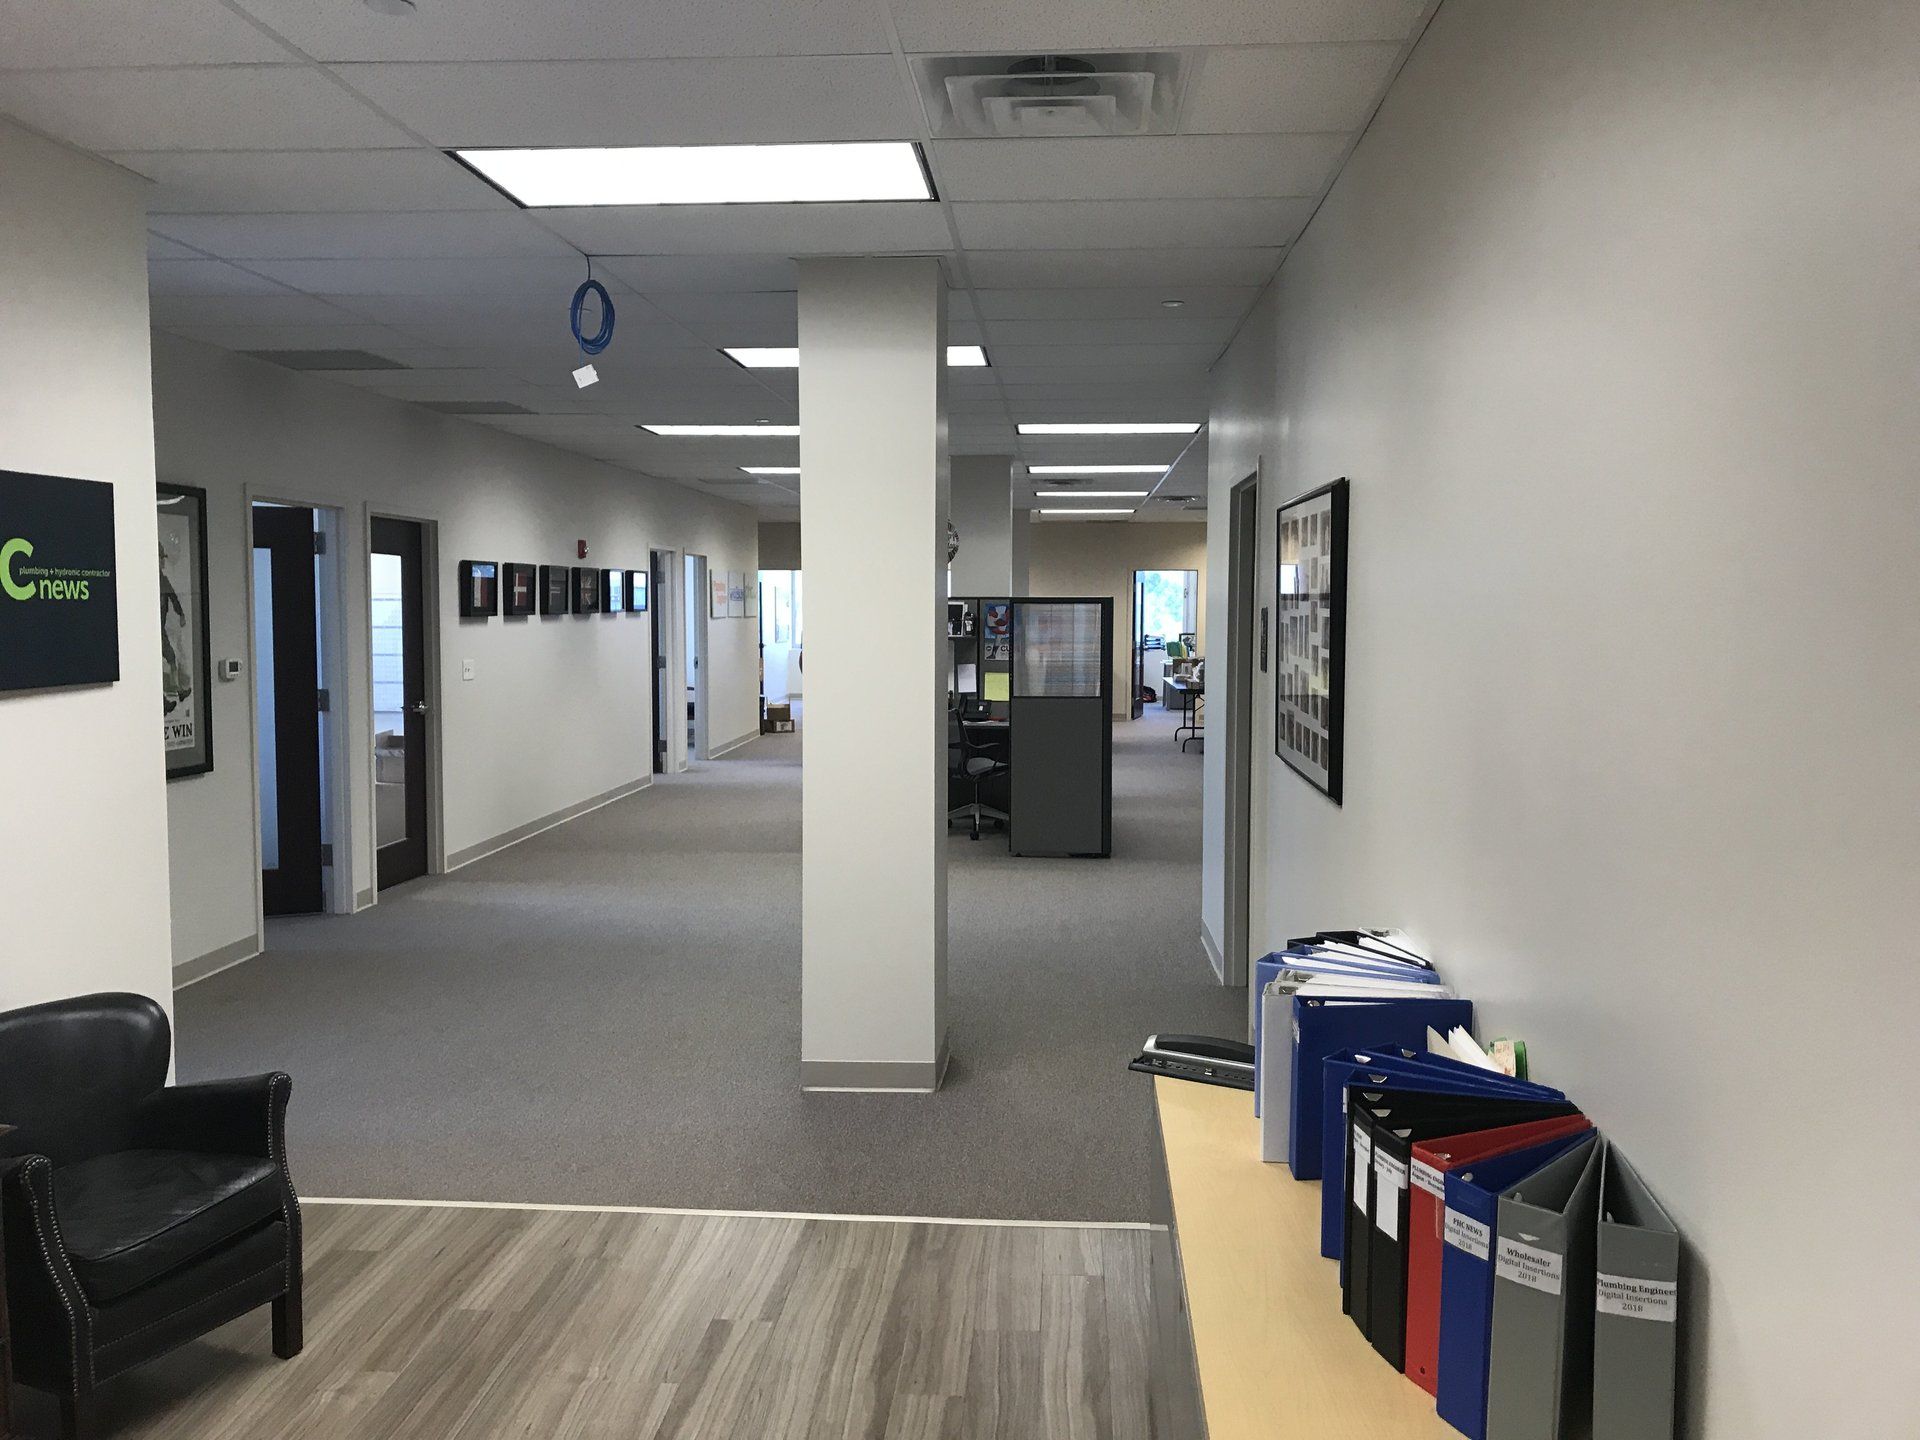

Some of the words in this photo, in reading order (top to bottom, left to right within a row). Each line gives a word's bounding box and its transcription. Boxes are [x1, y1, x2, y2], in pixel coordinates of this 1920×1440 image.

[19, 566, 49, 577] plumbing
[54, 567, 81, 577] hydronic
[81, 569, 111, 577] contractor
[40, 579, 90, 600] news
[172, 722, 193, 739] WIN
[1453, 1217, 1465, 1229] PHC
[1465, 1224, 1483, 1238] NEWS
[1461, 1231, 1489, 1249] Insertions
[1507, 1247, 1552, 1268] Wholesaler
[1498, 1254, 1521, 1268] Digital
[1522, 1262, 1561, 1281] Insertions
[1518, 1270, 1537, 1283] 2018
[1598, 1289, 1624, 1300] Digital
[1626, 1293, 1668, 1305] Insertions
[1622, 1302, 1644, 1312] 2018
